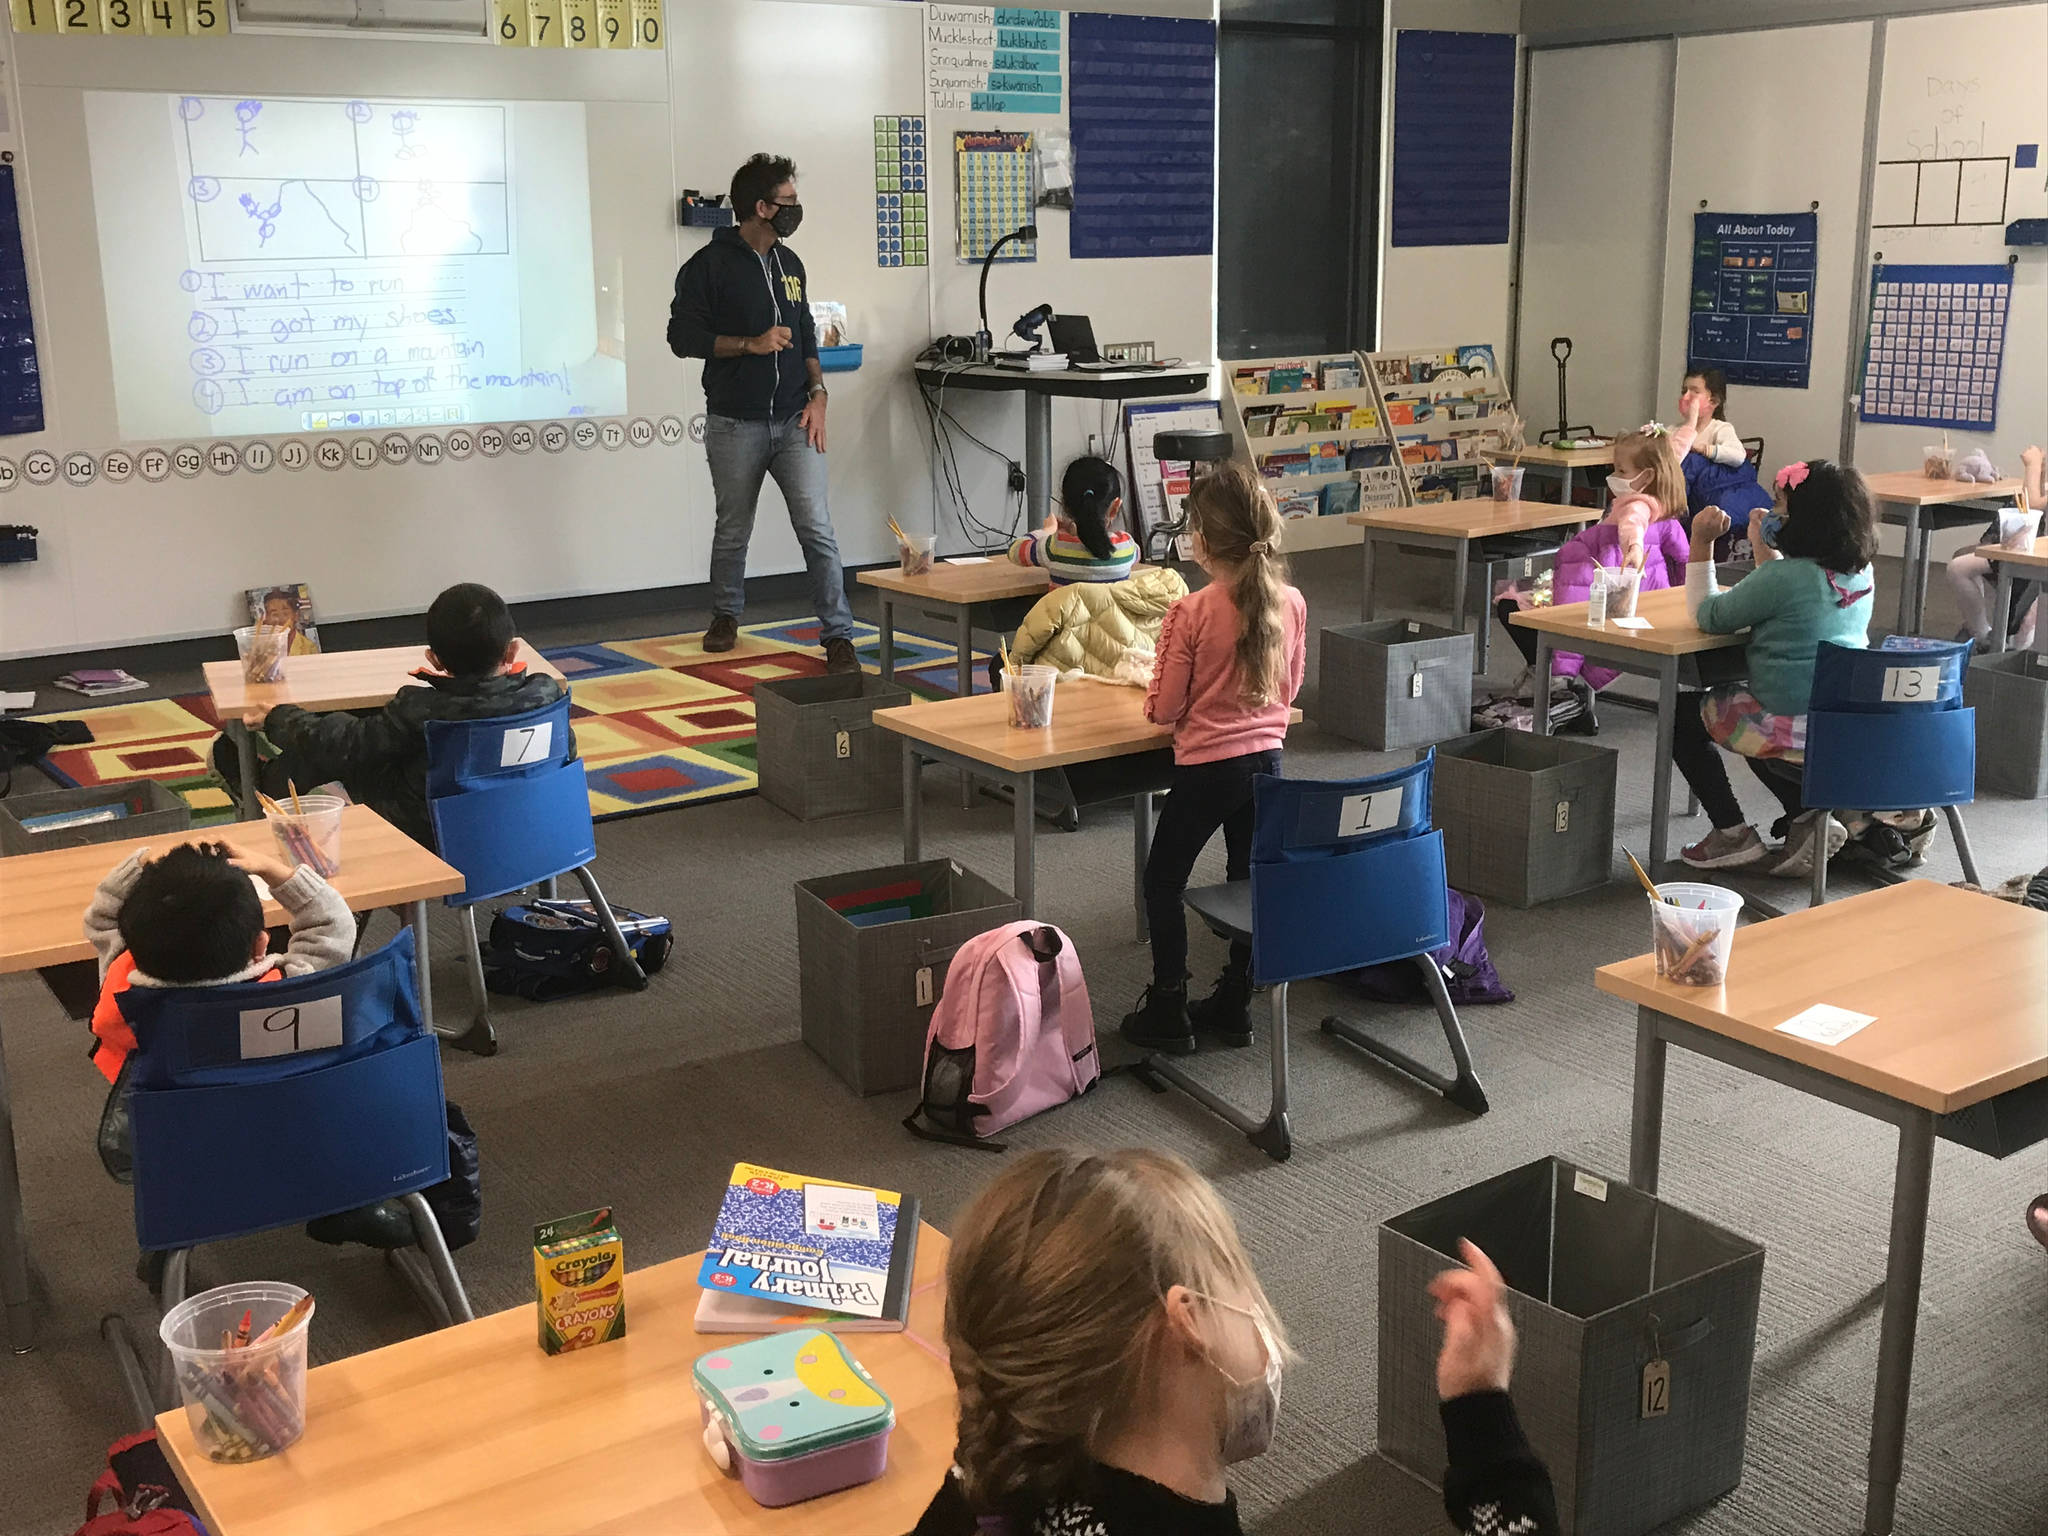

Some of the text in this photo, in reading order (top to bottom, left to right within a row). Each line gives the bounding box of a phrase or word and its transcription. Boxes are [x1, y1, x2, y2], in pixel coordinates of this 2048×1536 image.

[27, 0, 216, 29] 1 2 3 4 5
[500, 14, 659, 43] 6 7 8 9 10
[1927, 76, 1981, 97] Days
[1942, 104, 1964, 124] of
[1906, 121, 1986, 161] School
[1717, 223, 1796, 237] All About Today
[207, 271, 228, 300] I
[244, 272, 311, 300] want
[330, 268, 355, 297] to
[369, 277, 405, 296] run
[224, 307, 249, 339] I
[271, 307, 316, 343] got
[333, 315, 368, 342] my
[231, 346, 256, 375] I
[269, 353, 309, 374] run
[331, 350, 358, 368] on
[374, 346, 389, 366] a
[228, 377, 259, 407] I
[274, 386, 315, 409] am
[328, 384, 356, 401] on
[372, 369, 406, 399] top
[412, 366, 437, 393] of
[28, 459, 51, 475] Cc
[68, 460, 92, 477] Dd
[107, 457, 129, 473] Ee
[145, 456, 164, 473] Ff
[176, 453, 200, 470] Gg
[212, 451, 235, 467] Hh
[321, 447, 341, 462] Kk
[385, 442, 408, 456] Mm
[418, 442, 440, 457] Nn
[450, 438, 470, 452] Oo
[511, 432, 532, 447] Qq
[546, 430, 564, 445] Rr
[577, 428, 595, 441] Ss
[606, 429, 620, 442] Tt
[632, 424, 650, 439] Uu
[661, 424, 680, 438] Vv
[1893, 669, 1923, 698] 13
[519, 728, 536, 763] 7
[840, 739, 848, 755] 6
[1355, 795, 1373, 830] 1
[1557, 810, 1568, 830] 13
[921, 980, 926, 1000] 1
[263, 1006, 300, 1051] 9
[751, 1178, 776, 1191] K-2
[540, 1226, 555, 1240] 24
[556, 1252, 612, 1272] Crayola
[718, 1248, 836, 1284] Journal
[751, 1271, 880, 1306] Primary
[555, 1304, 617, 1331] CRAYONS
[580, 1329, 594, 1341] 24
[1647, 1376, 1666, 1411] 12
